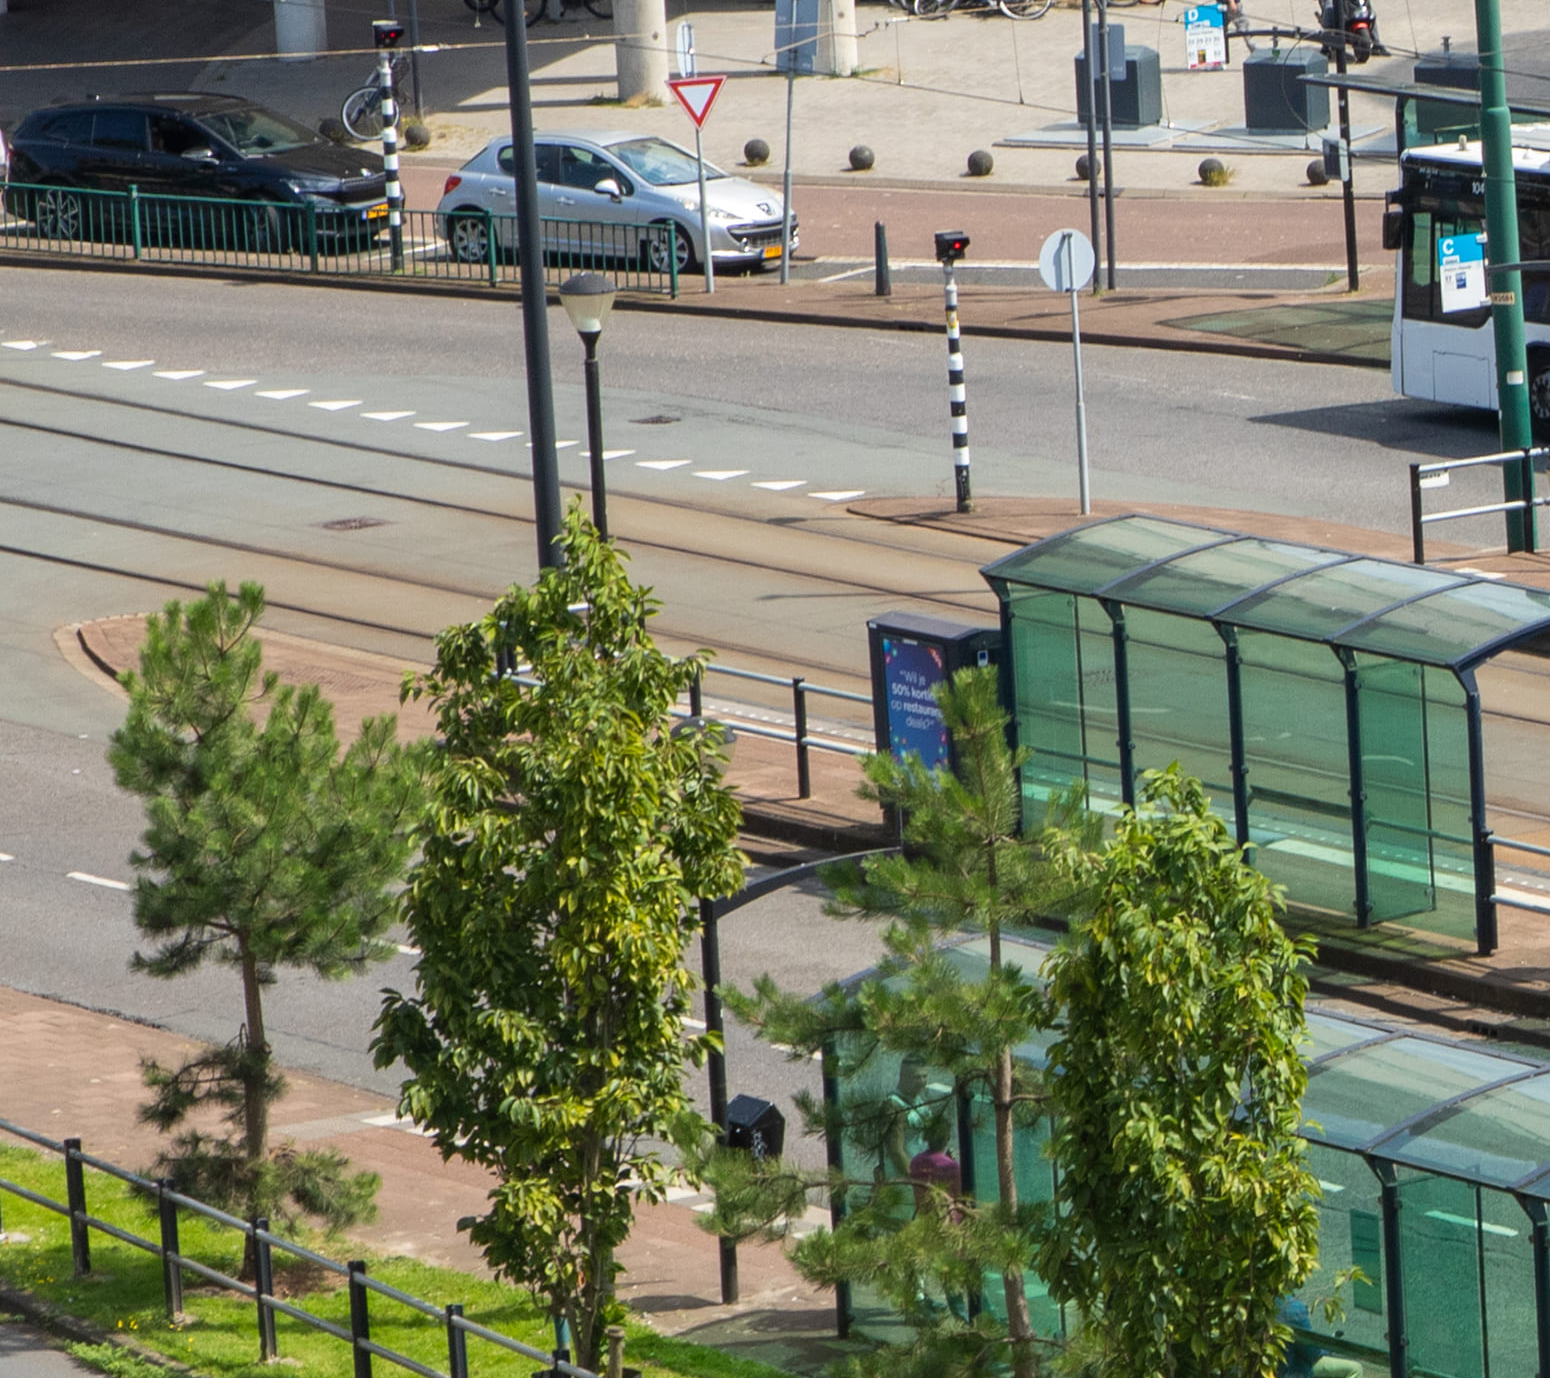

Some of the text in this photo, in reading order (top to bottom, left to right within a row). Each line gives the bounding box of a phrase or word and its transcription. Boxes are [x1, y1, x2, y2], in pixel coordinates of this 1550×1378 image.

[1187, 9, 1199, 22] D
[1471, 181, 1486, 194] 104
[1442, 239, 1455, 255] C
[892, 682, 911, 697] 50%
[891, 699, 902, 711] op
